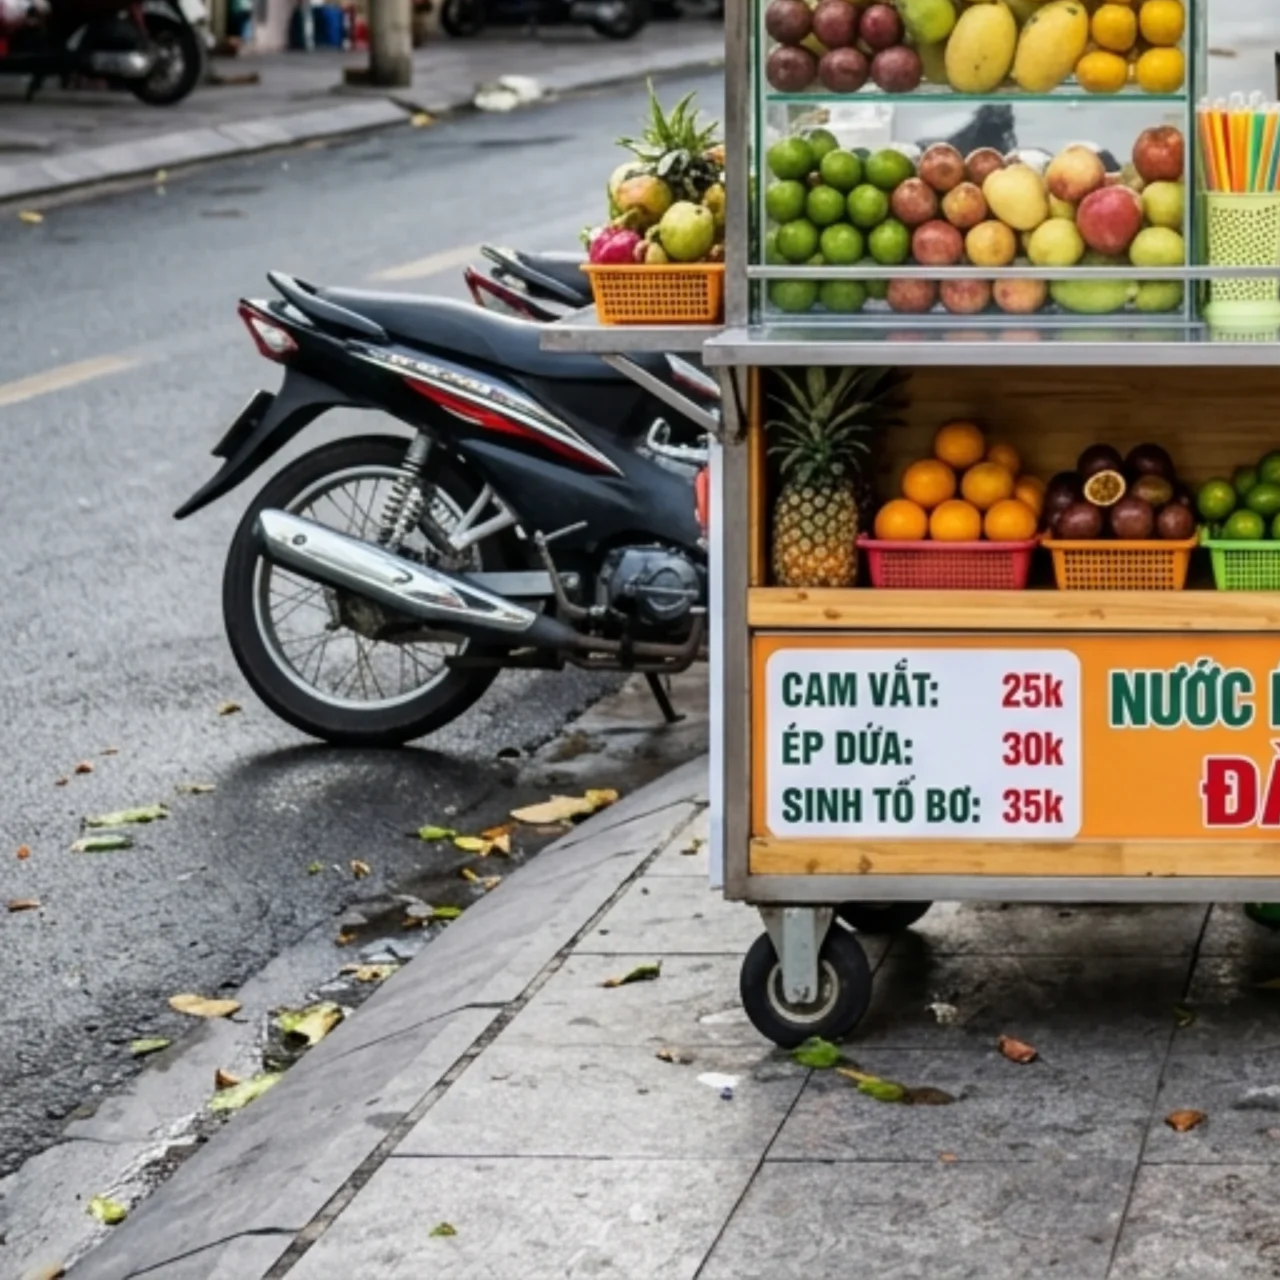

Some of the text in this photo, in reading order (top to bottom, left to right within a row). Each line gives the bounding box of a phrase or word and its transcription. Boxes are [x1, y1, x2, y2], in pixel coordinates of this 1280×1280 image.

[782, 671, 857, 708] CAM
[1001, 672, 1064, 708] 25k
[1110, 658, 1253, 727] NƯỚC
[782, 721, 1064, 766] ÉP DỨA: 30k
[781, 775, 1064, 824] SINH TỐ BƠ: 35k
